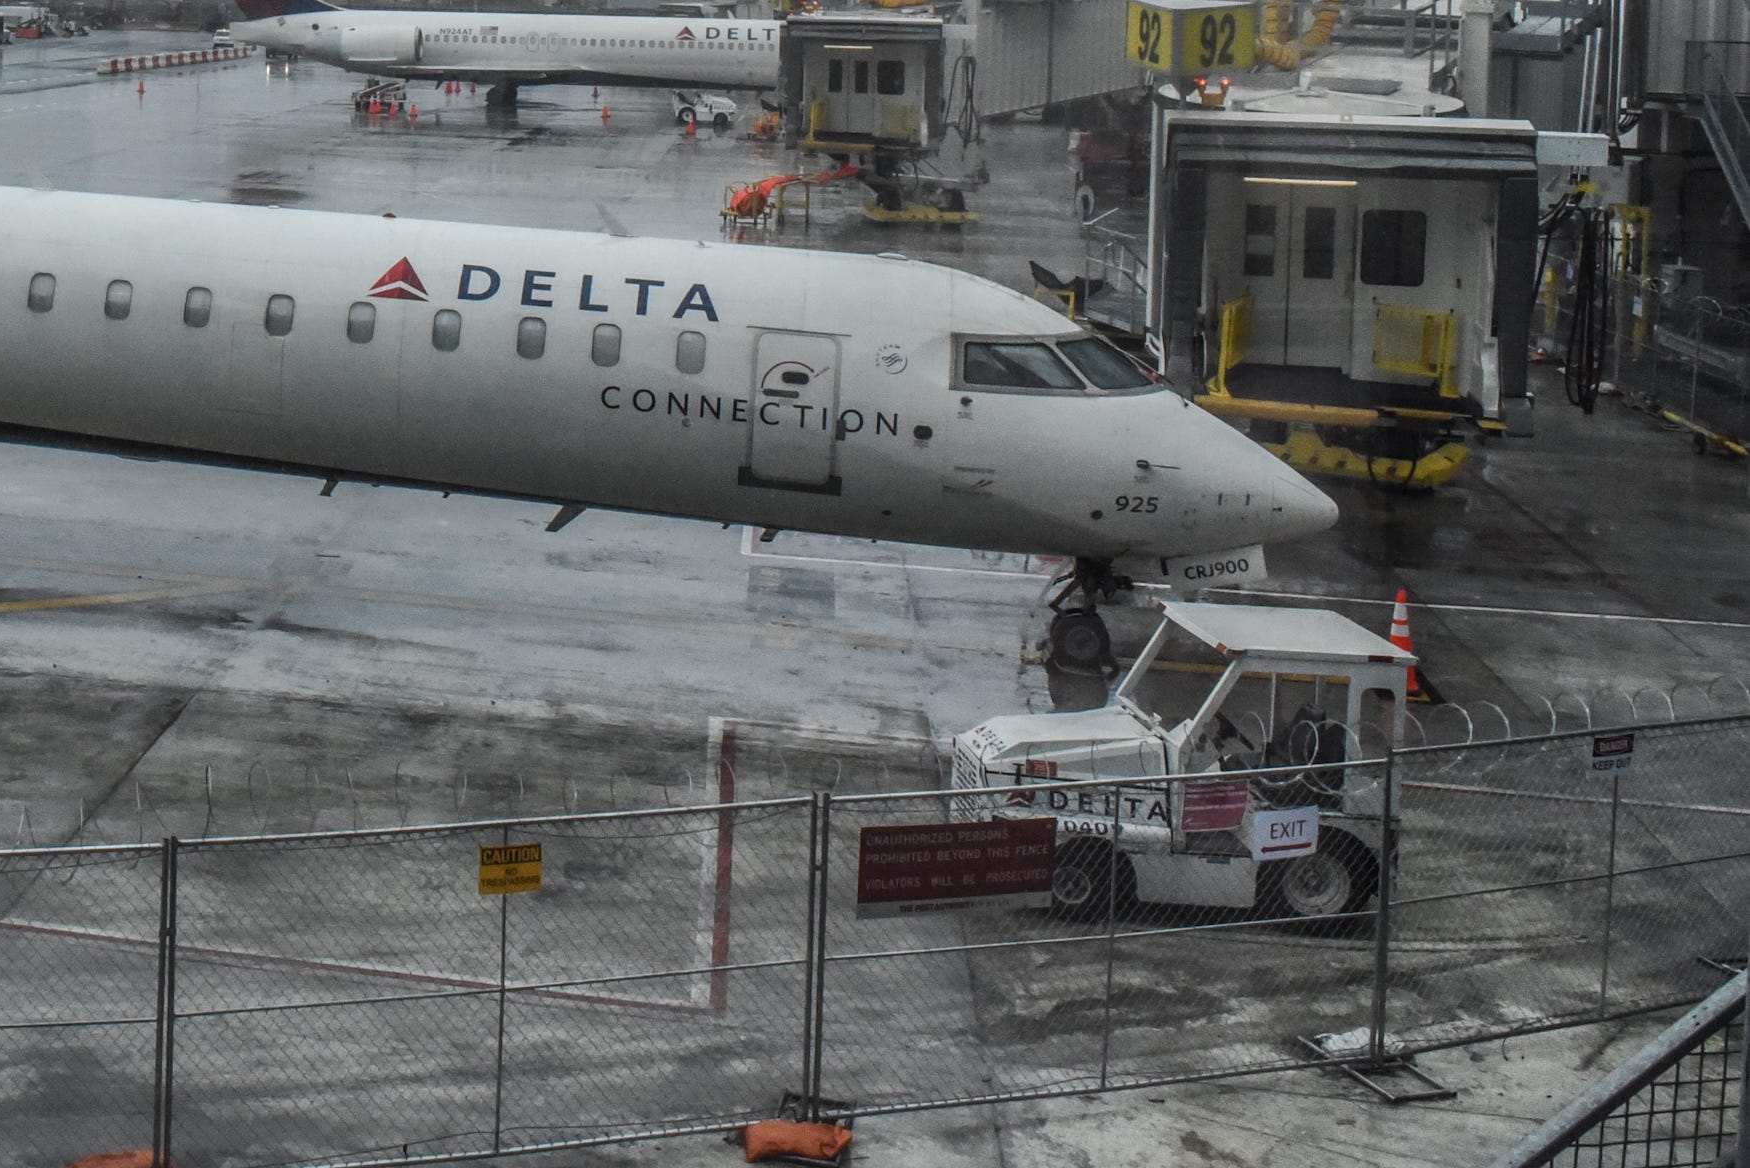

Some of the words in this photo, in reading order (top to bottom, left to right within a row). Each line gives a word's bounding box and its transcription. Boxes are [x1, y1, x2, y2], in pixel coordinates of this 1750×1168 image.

[705, 27, 776, 41] DELT
[1138, 9, 1161, 64] 92
[1200, 13, 1236, 67] 92
[457, 264, 719, 322] DELTA
[600, 386, 900, 437] CONNECTION
[1115, 495, 1159, 514] 925
[1184, 558, 1249, 581] CRJ900
[1593, 759, 1615, 771] KEEP
[1616, 757, 1632, 769] OUT
[1050, 790, 1168, 822] DELTA
[866, 832, 953, 846] UNAUTHORIZED
[958, 828, 1009, 841] PERSONS
[1270, 819, 1306, 840] EXIT
[483, 846, 540, 864] CAUTION
[865, 851, 931, 865] PROHIBITED
[937, 848, 982, 861] BEYOND
[987, 846, 1010, 858] THIS
[1016, 844, 1050, 856] FENCE
[865, 877, 921, 891] VIOLATORS
[931, 876, 954, 887] WILL
[986, 869, 1049, 882] PROSECUTED
